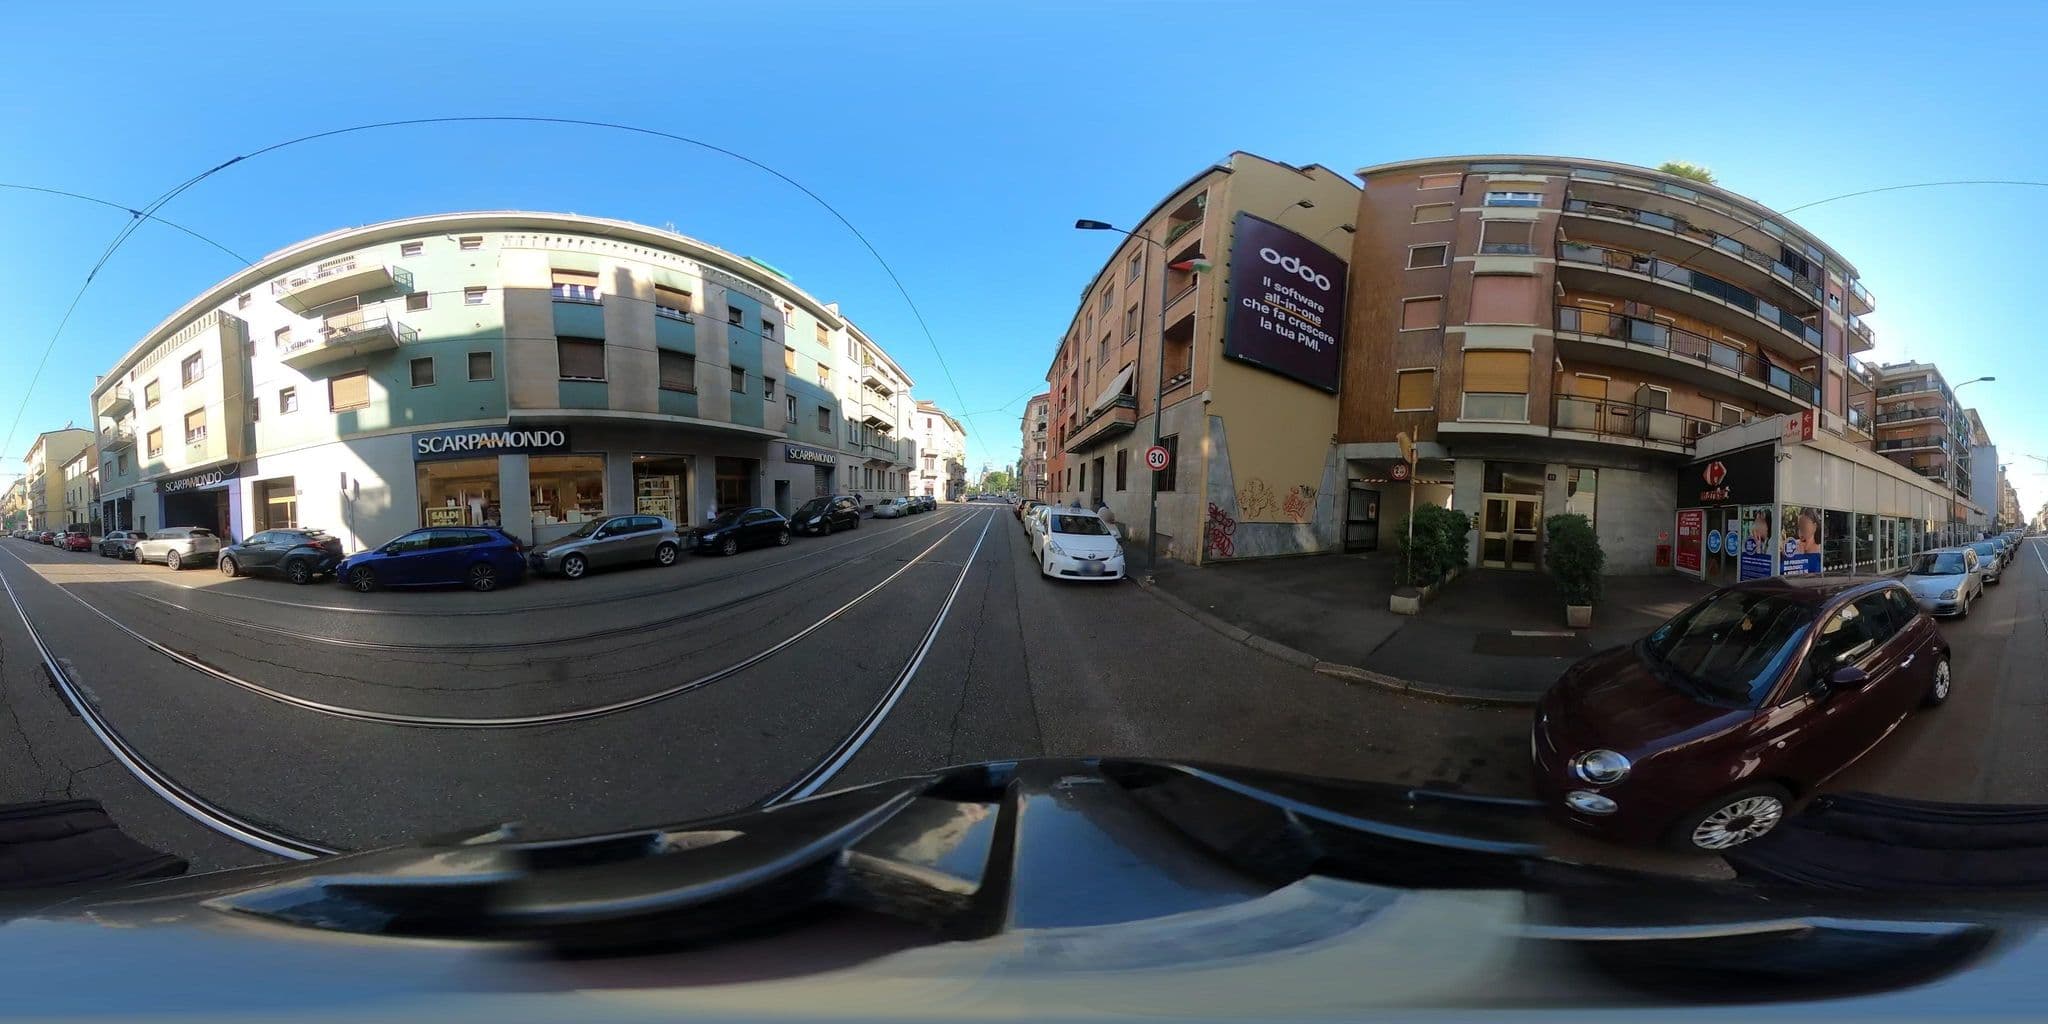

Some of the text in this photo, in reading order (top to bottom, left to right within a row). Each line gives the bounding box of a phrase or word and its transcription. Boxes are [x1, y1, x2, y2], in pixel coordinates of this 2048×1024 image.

[1259, 247, 1331, 291] odoo
[1263, 276, 1325, 314] Il software
[1264, 291, 1322, 325] all-in-one
[1242, 297, 1335, 345] che fa crescere
[1260, 316, 1321, 352] la tua PMI.
[418, 430, 565, 454] SCARPAMONDO
[789, 448, 836, 464] SCARPAMONDO
[1151, 452, 1164, 464] 30
[165, 471, 222, 493] SCARPAMONDO
[431, 510, 459, 520] SALDI
